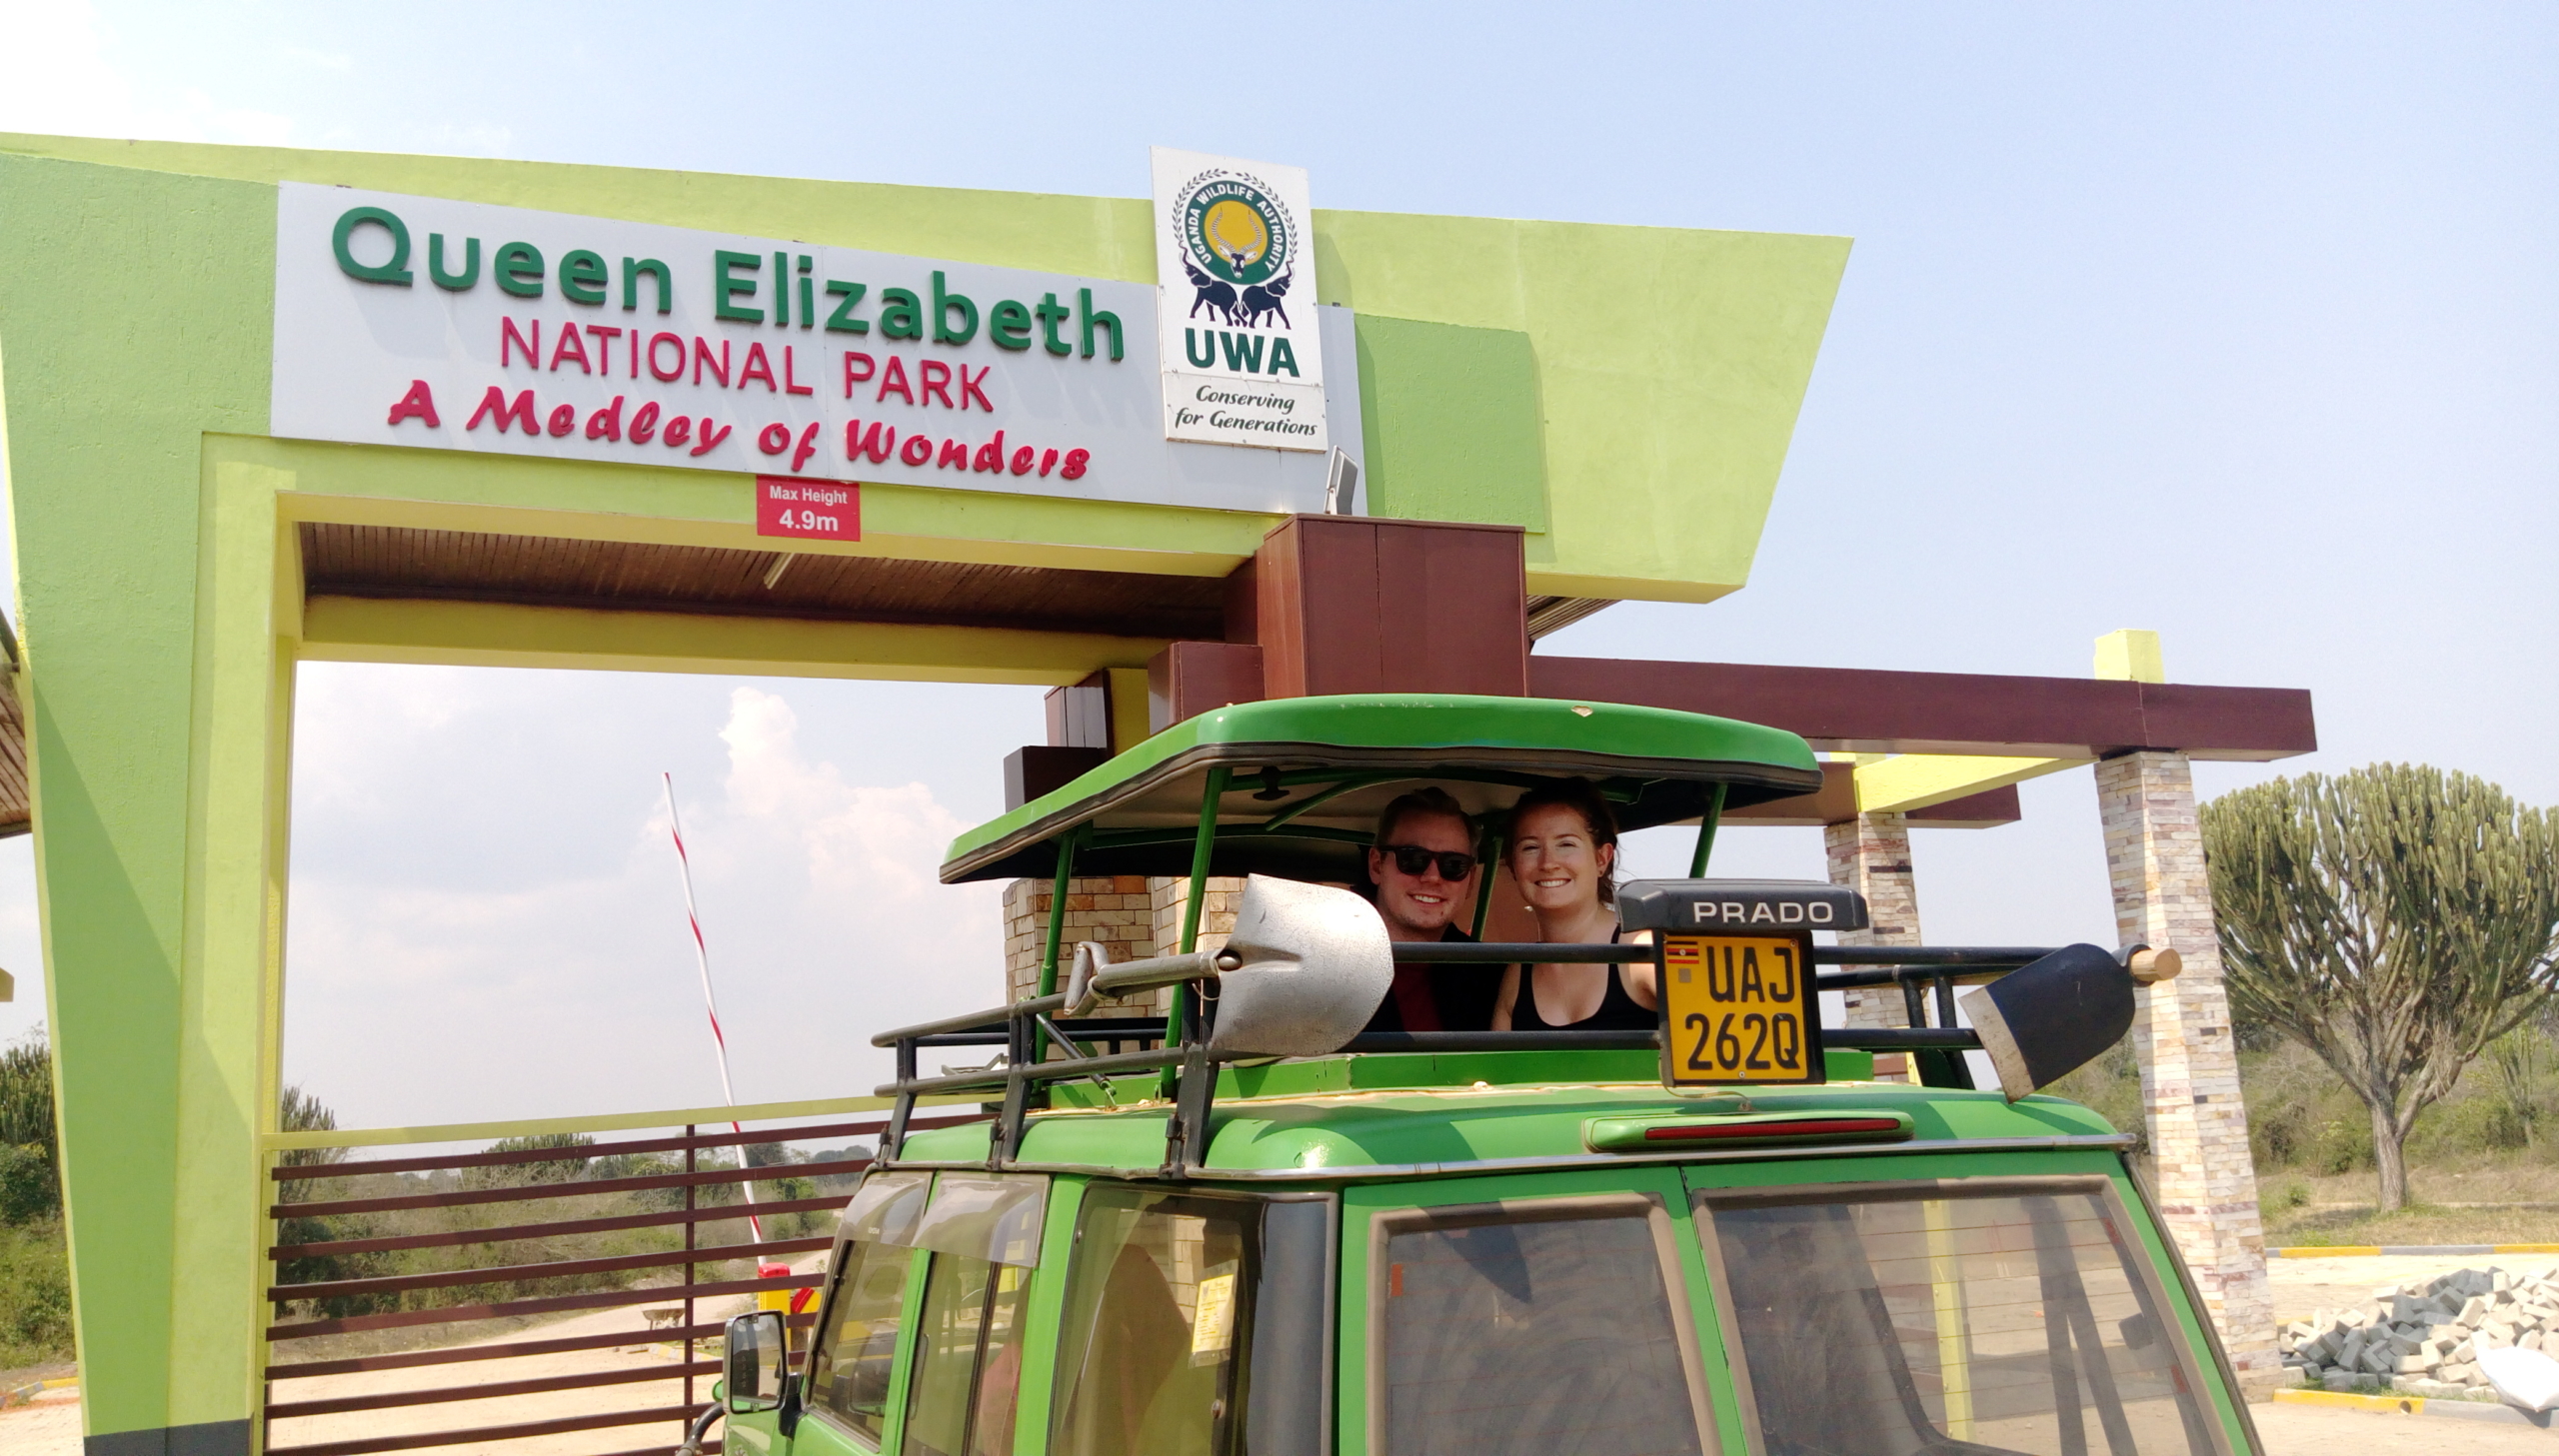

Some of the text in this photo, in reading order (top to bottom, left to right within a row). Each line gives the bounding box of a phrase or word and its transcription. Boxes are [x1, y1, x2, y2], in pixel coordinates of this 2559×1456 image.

[1189, 184, 1283, 272] UGANDA WILDLIFE AUTHORITY
[332, 206, 1125, 362] Queen Elizabeth
[501, 315, 994, 413] NATIONAL PARK
[1186, 327, 1300, 378] UWA
[1175, 407, 1317, 436] for Generations
[1196, 385, 1295, 415] Conserving
[388, 379, 1091, 481] A Medley of Wonders
[770, 485, 848, 507] Max Height
[779, 509, 839, 532] 4.9m
[1693, 901, 1833, 924] PRADO
[1706, 945, 1795, 1003] UAJ
[1685, 1012, 1800, 1070] 262Q
